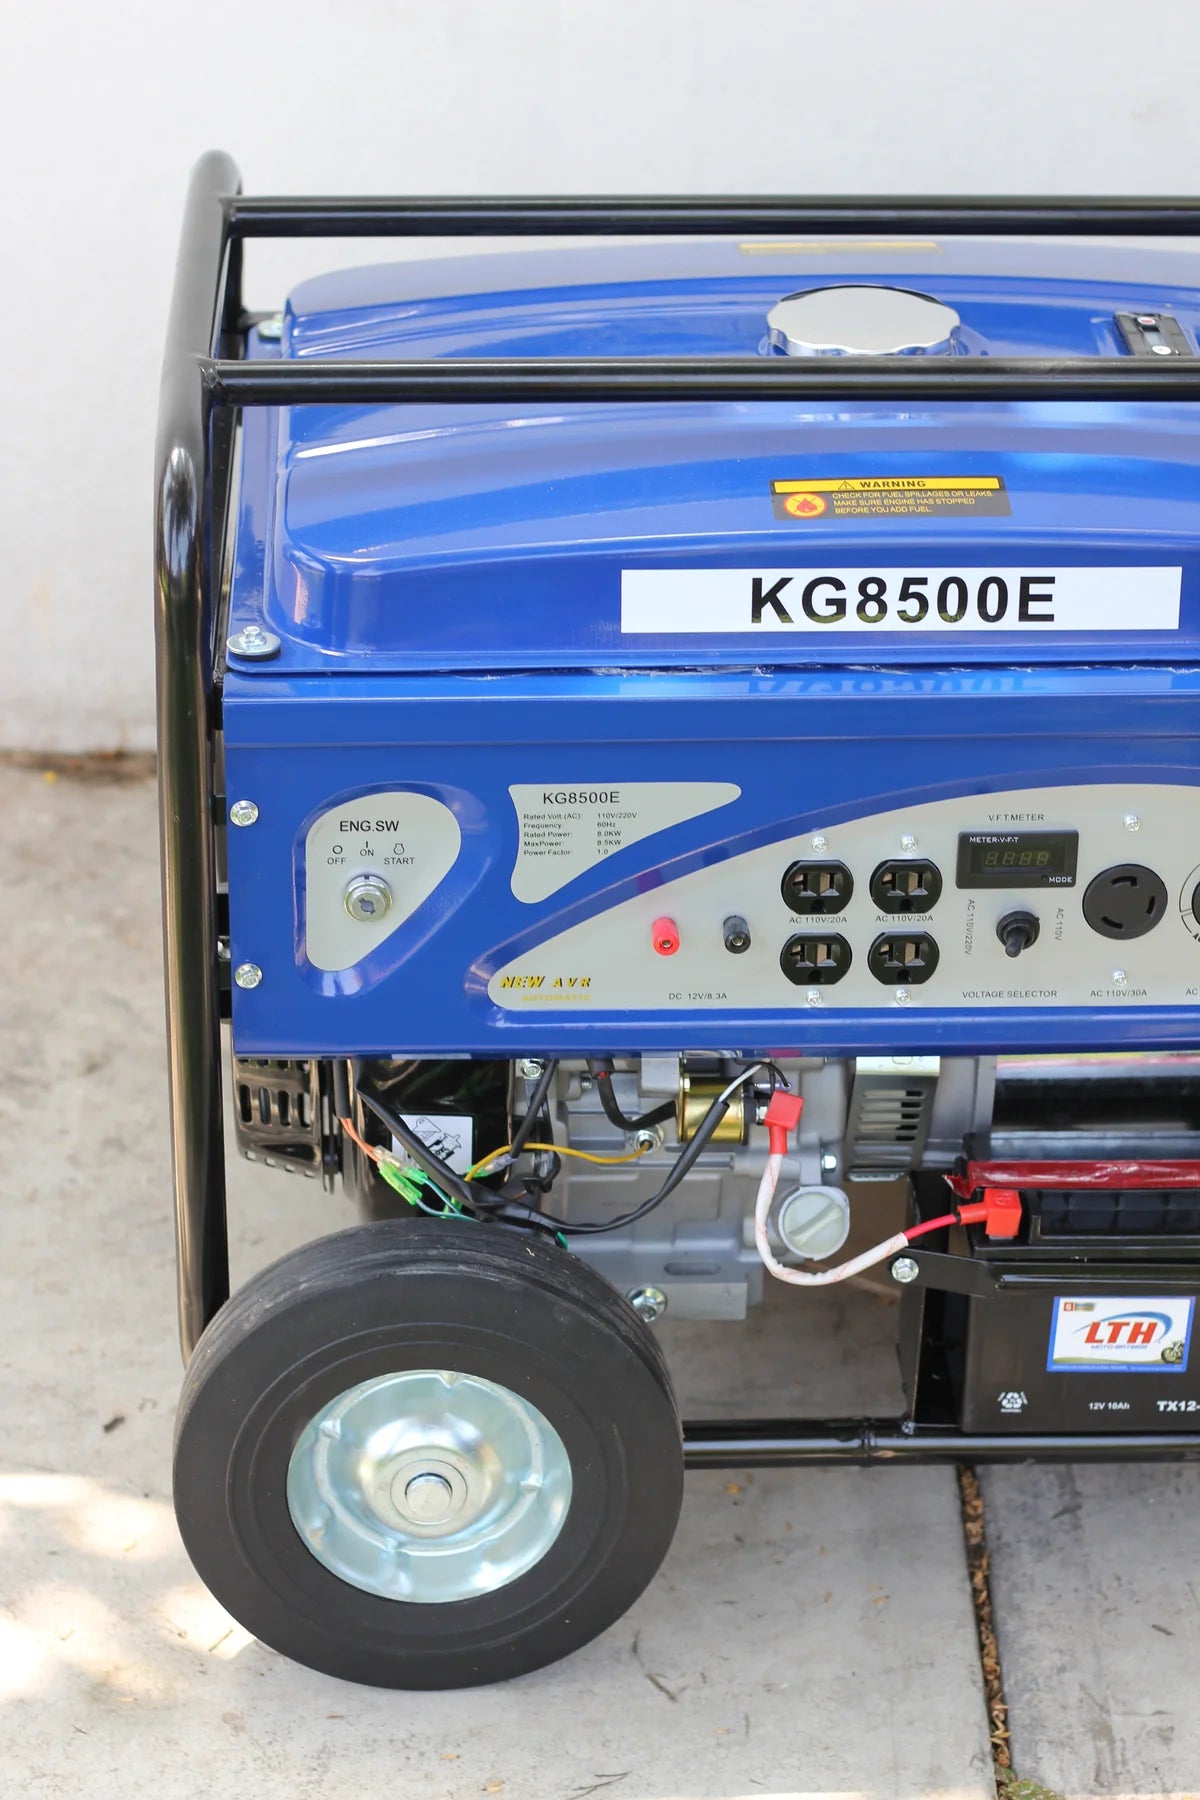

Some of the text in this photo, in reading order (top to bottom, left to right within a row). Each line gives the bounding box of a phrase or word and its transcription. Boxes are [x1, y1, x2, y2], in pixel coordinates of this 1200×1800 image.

[859, 480, 927, 488] WARNING
[832, 491, 862, 499] CHECK
[905, 490, 950, 498] SPILLAGES
[751, 576, 1056, 624] KG8500E
[543, 791, 620, 804] KG8500E
[339, 820, 399, 832] ENG.SW
[359, 849, 374, 857] ON
[327, 857, 347, 865] OFF
[383, 857, 415, 865] START
[965, 899, 975, 956] AC 110V/220V
[1055, 908, 1064, 941] AC 110V
[501, 976, 545, 988] NEW
[687, 992, 728, 1000] 12V/8.3A
[1007, 990, 1058, 998] SELECTOR
[1106, 989, 1147, 997] 110V/30A
[1186, 988, 1198, 996] AC
[521, 994, 591, 1002] AUTOMATIC
[1084, 1321, 1158, 1344] LTH
[1089, 1402, 1104, 1410] 12V
